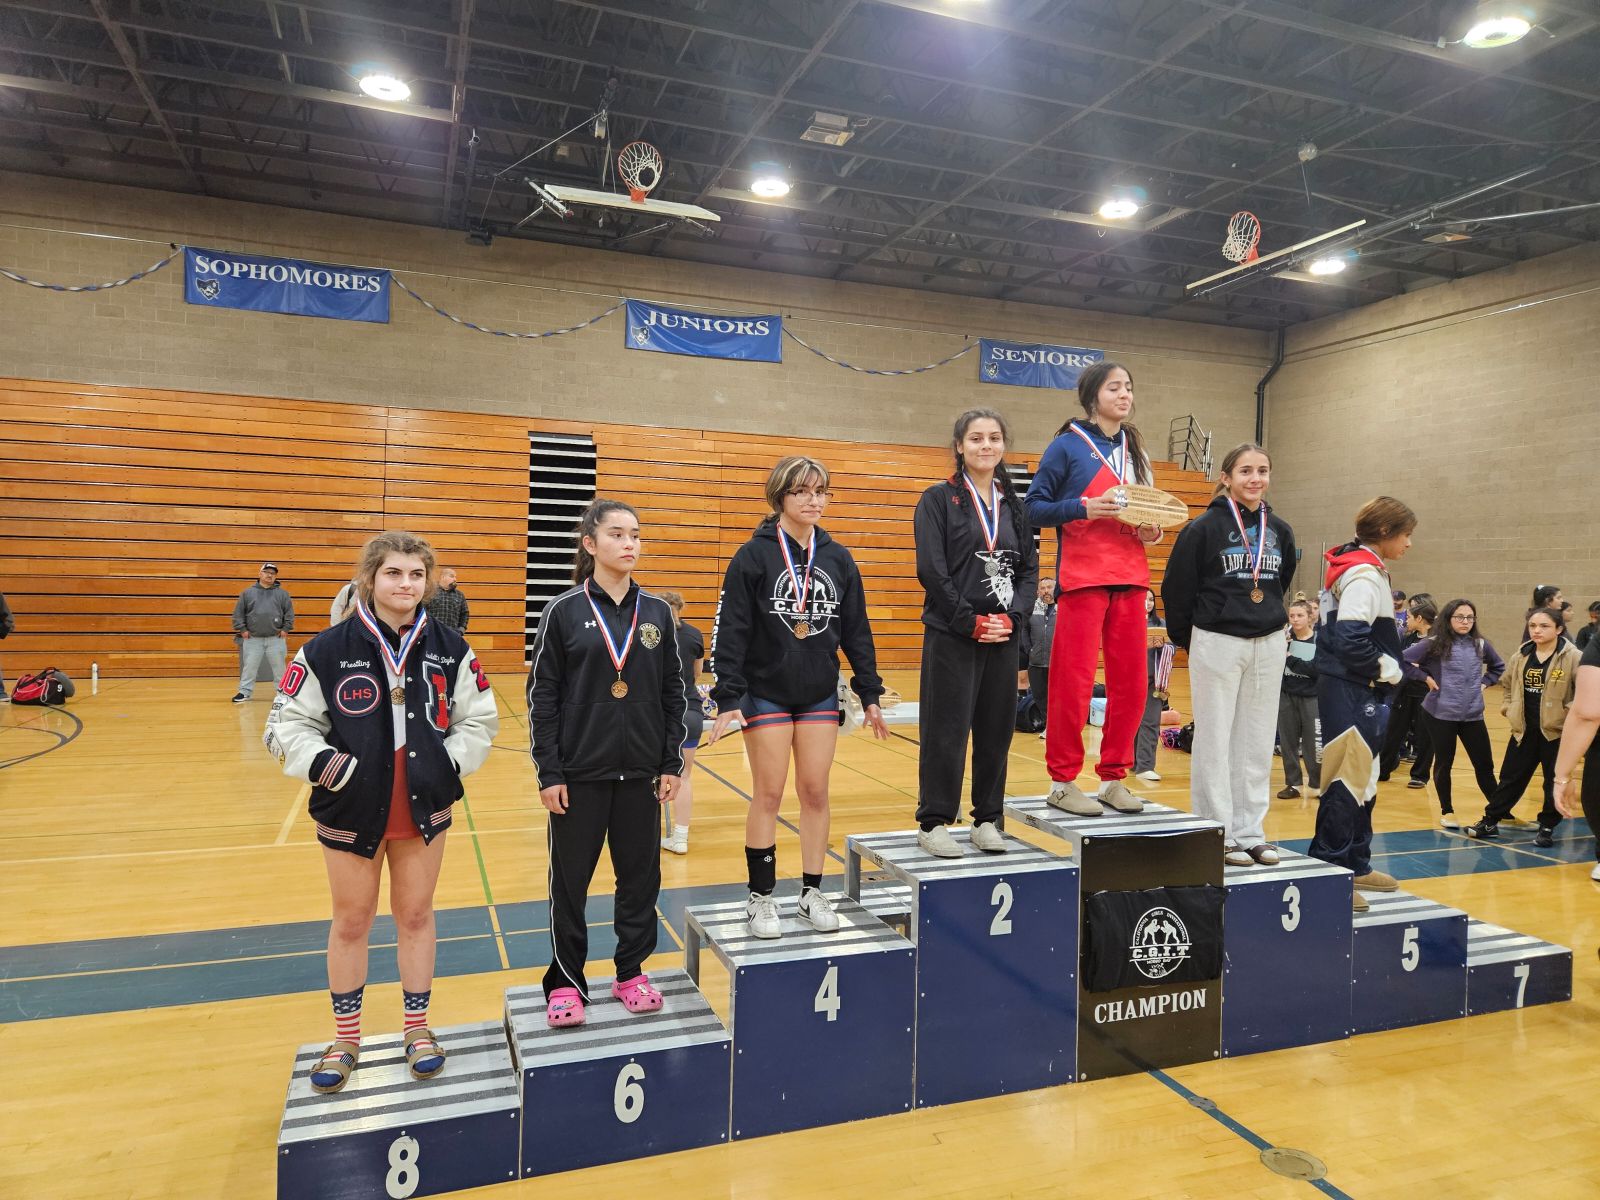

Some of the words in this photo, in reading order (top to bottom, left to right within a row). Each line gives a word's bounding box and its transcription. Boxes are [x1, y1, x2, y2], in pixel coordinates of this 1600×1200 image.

[195, 255, 381, 293] SOPHOMORES
[643, 309, 770, 336] JUNIORS
[991, 347, 1095, 368] SENIORS
[1222, 554, 1245, 574] LADY
[339, 660, 371, 669] Wrestling
[343, 688, 373, 700] LHS
[990, 882, 1013, 936] 2
[1281, 885, 1301, 933] 3
[1132, 946, 1189, 958] C.G.I.T
[1401, 927, 1419, 972] 5
[815, 966, 841, 1022] 4
[1094, 988, 1207, 1024] CHAMPION
[1514, 965, 1530, 1009] 7
[613, 1062, 646, 1124] 6
[385, 1135, 420, 1200] 8
